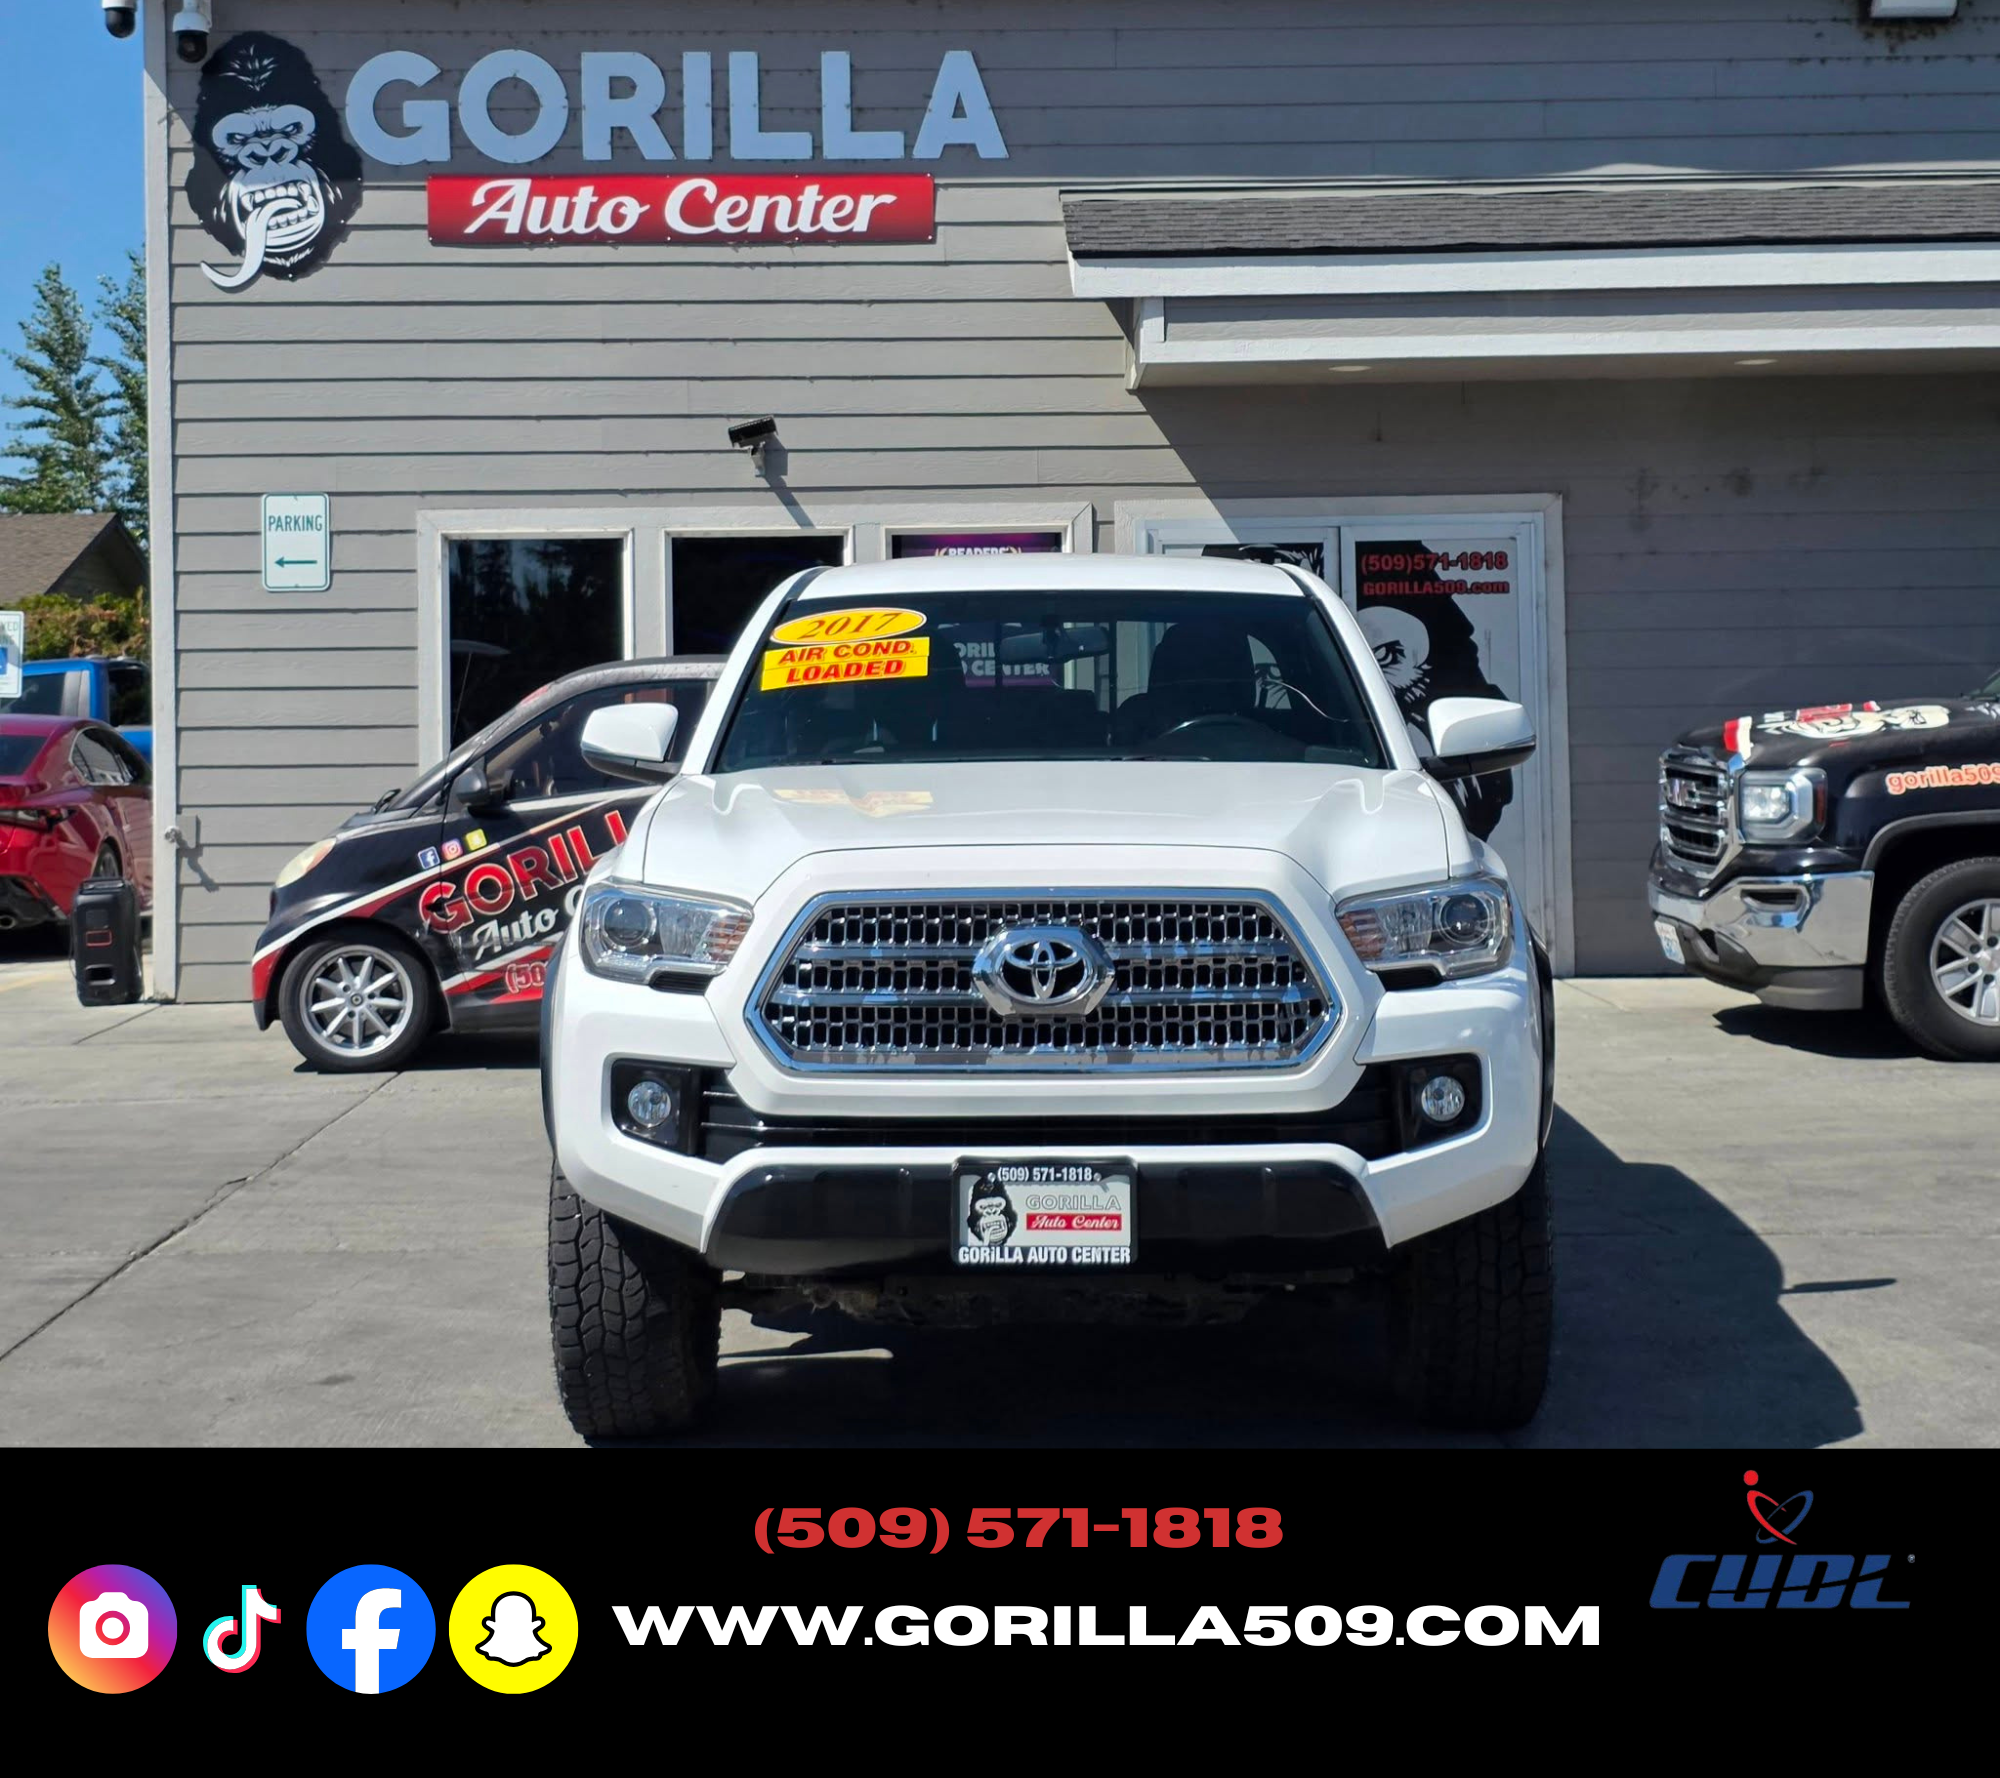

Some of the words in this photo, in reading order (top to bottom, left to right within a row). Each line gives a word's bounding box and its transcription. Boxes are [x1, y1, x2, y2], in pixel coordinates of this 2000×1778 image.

[345, 49, 1010, 165] GORILLA
[463, 178, 649, 235] Auto
[664, 178, 897, 235] Center
[268, 515, 323, 532] PARKING
[1360, 551, 1509, 575] (509)571-1818
[1363, 579, 1510, 595] GORILLA509.com
[797, 612, 903, 640] 2017
[778, 646, 825, 665] AIR
[833, 640, 917, 659] COND.
[786, 659, 906, 685] LOADED
[472, 908, 559, 960] Auto
[505, 961, 548, 994] (50
[997, 1166, 1029, 1182] (509)
[1032, 1166, 1092, 1182] 571-1818
[1025, 1194, 1121, 1210] GORILLA
[1030, 1214, 1068, 1230] Auto
[1071, 1214, 1120, 1230] Center
[958, 1246, 1024, 1264] GORILLA
[1027, 1246, 1068, 1264] AUTO
[1071, 1246, 1131, 1264] CENTER
